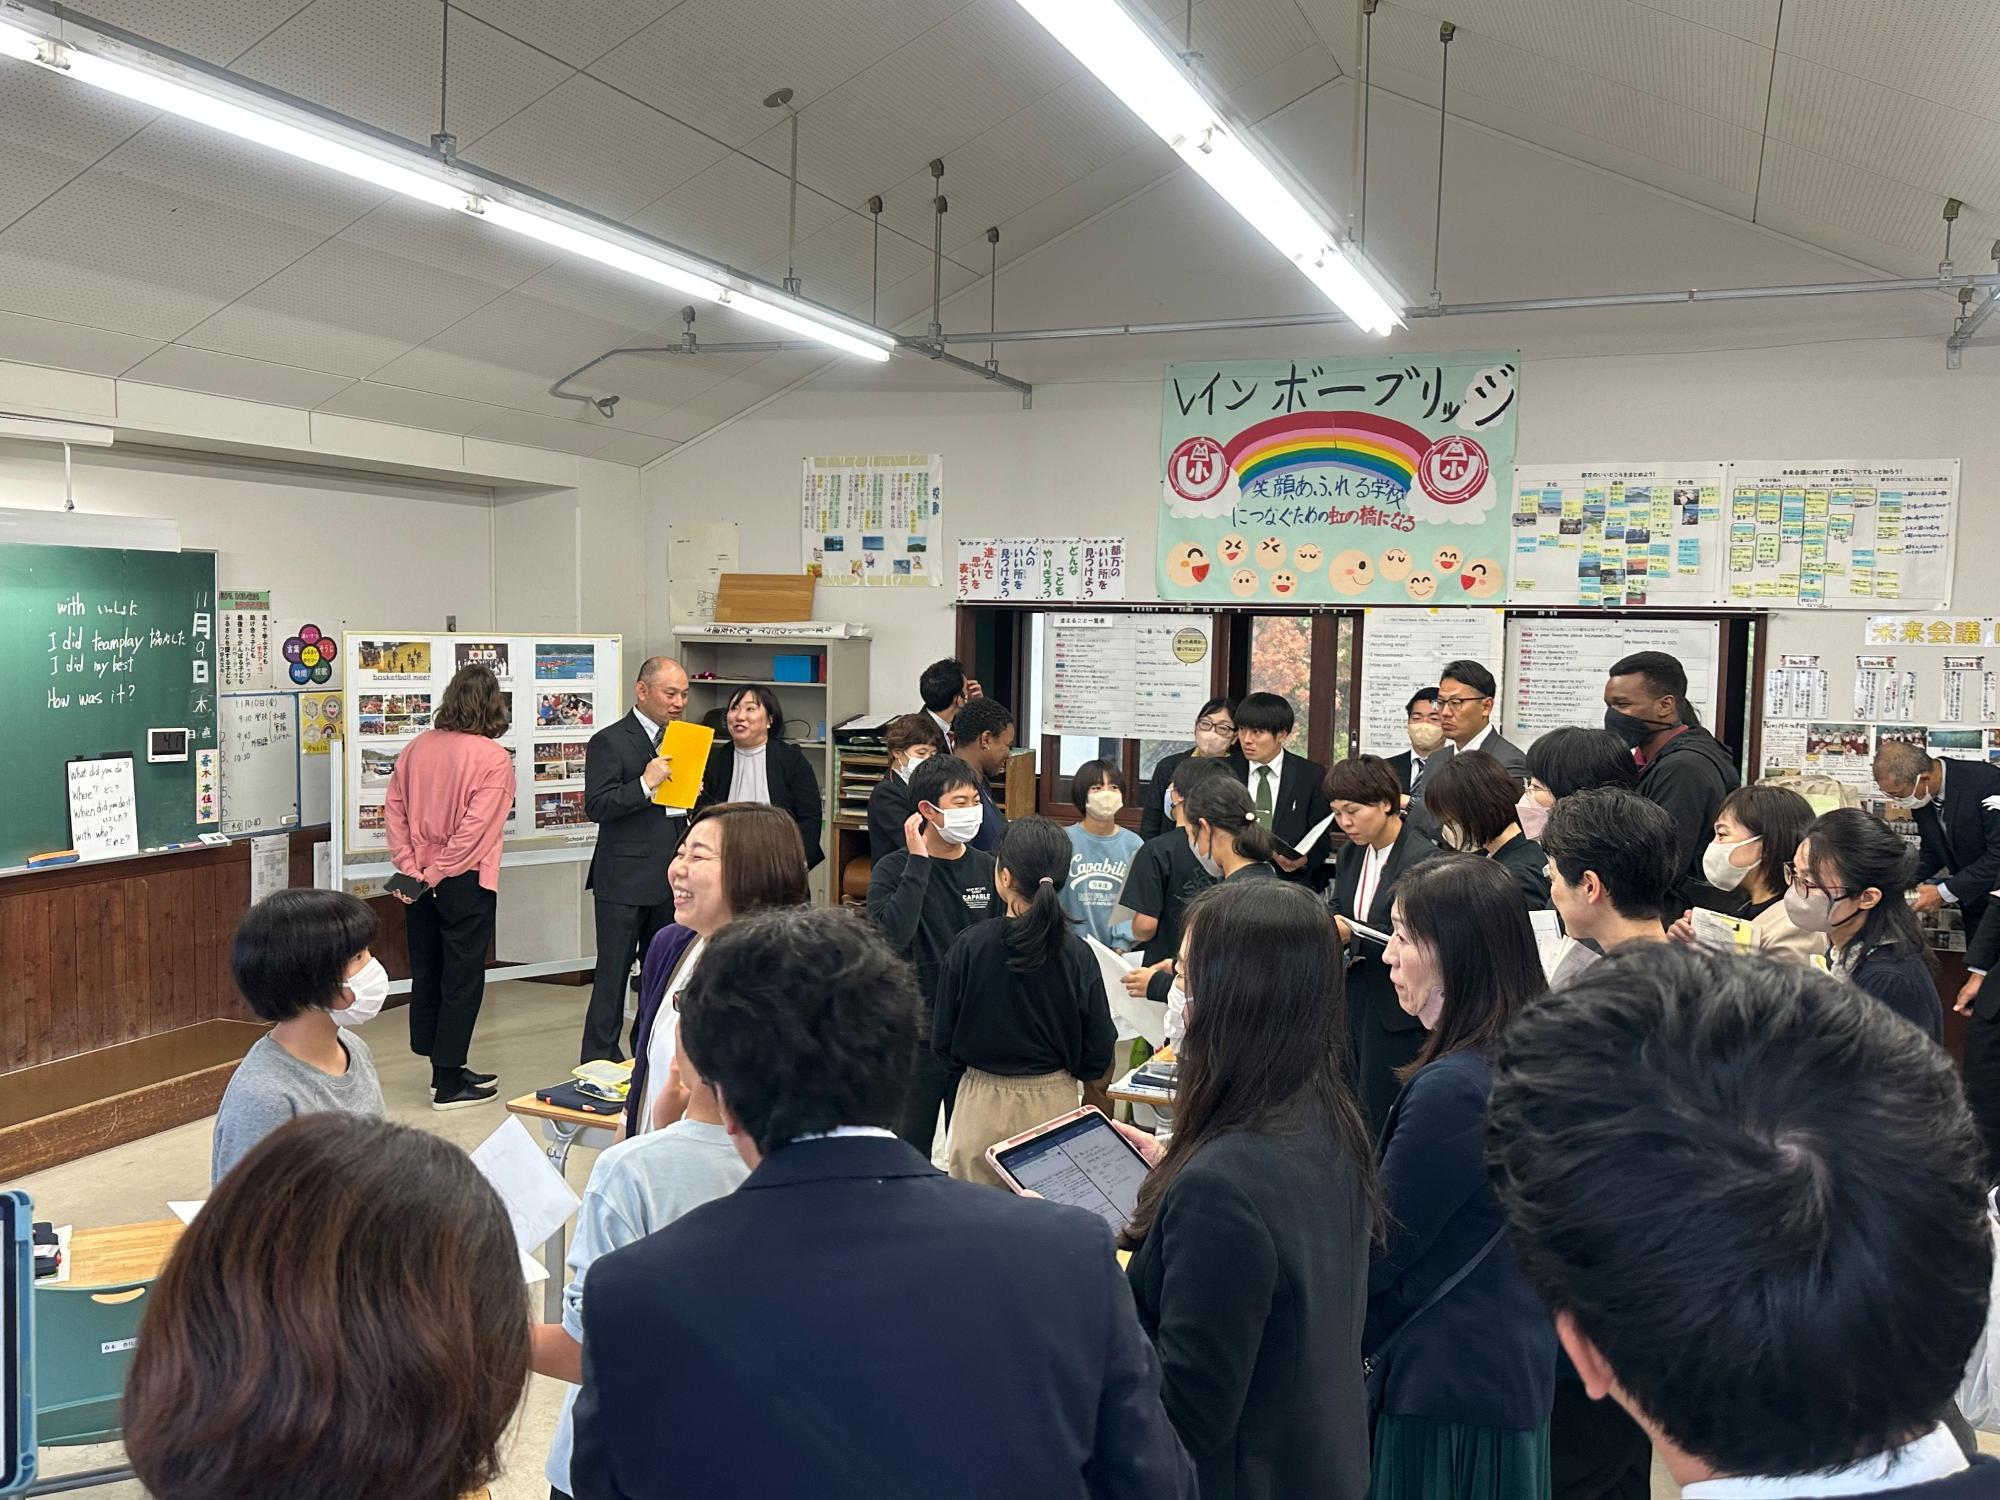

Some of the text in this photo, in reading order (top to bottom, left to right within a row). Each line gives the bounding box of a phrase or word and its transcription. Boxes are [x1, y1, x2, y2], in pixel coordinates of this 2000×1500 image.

[1173, 363, 1515, 426] レインボーブリッジ
[1252, 476, 1406, 509] 笑顔あふれる学校
[1232, 507, 1416, 532] につなぐための虹の橋になる
[984, 546, 994, 580] 進んで
[1013, 548, 1024, 590] いい所を
[1026, 546, 1035, 567] 人の
[1069, 546, 1078, 576] どんな
[1098, 548, 1108, 590] いい所を
[1111, 545, 1121, 577] 都万の
[959, 563, 969, 596] 表そう
[971, 556, 981, 590] 思いを
[1001, 548, 1010, 598] 見つけよう
[1043, 550, 1052, 598] やりきろう
[1055, 567, 1065, 596] ことも
[1085, 548, 1095, 598] 見つけよう
[58, 592, 85, 616] with
[48, 632, 57, 652] I
[62, 626, 83, 650] did
[92, 627, 144, 657] teamplay
[1872, 620, 1981, 644] 未来会議
[287, 644, 300, 654] 言葉
[319, 644, 334, 653] そうじ
[51, 653, 134, 678] I did my best
[48, 684, 136, 708] How was it?
[399, 726, 416, 734] field
[70, 766, 87, 780] What
[89, 763, 100, 777] did
[72, 785, 98, 801] Where?
[74, 805, 96, 819] When
[97, 800, 108, 813] did
[75, 827, 92, 842] with
[1069, 853, 1127, 878] Capabili
[963, 893, 990, 901] CAPABLE
